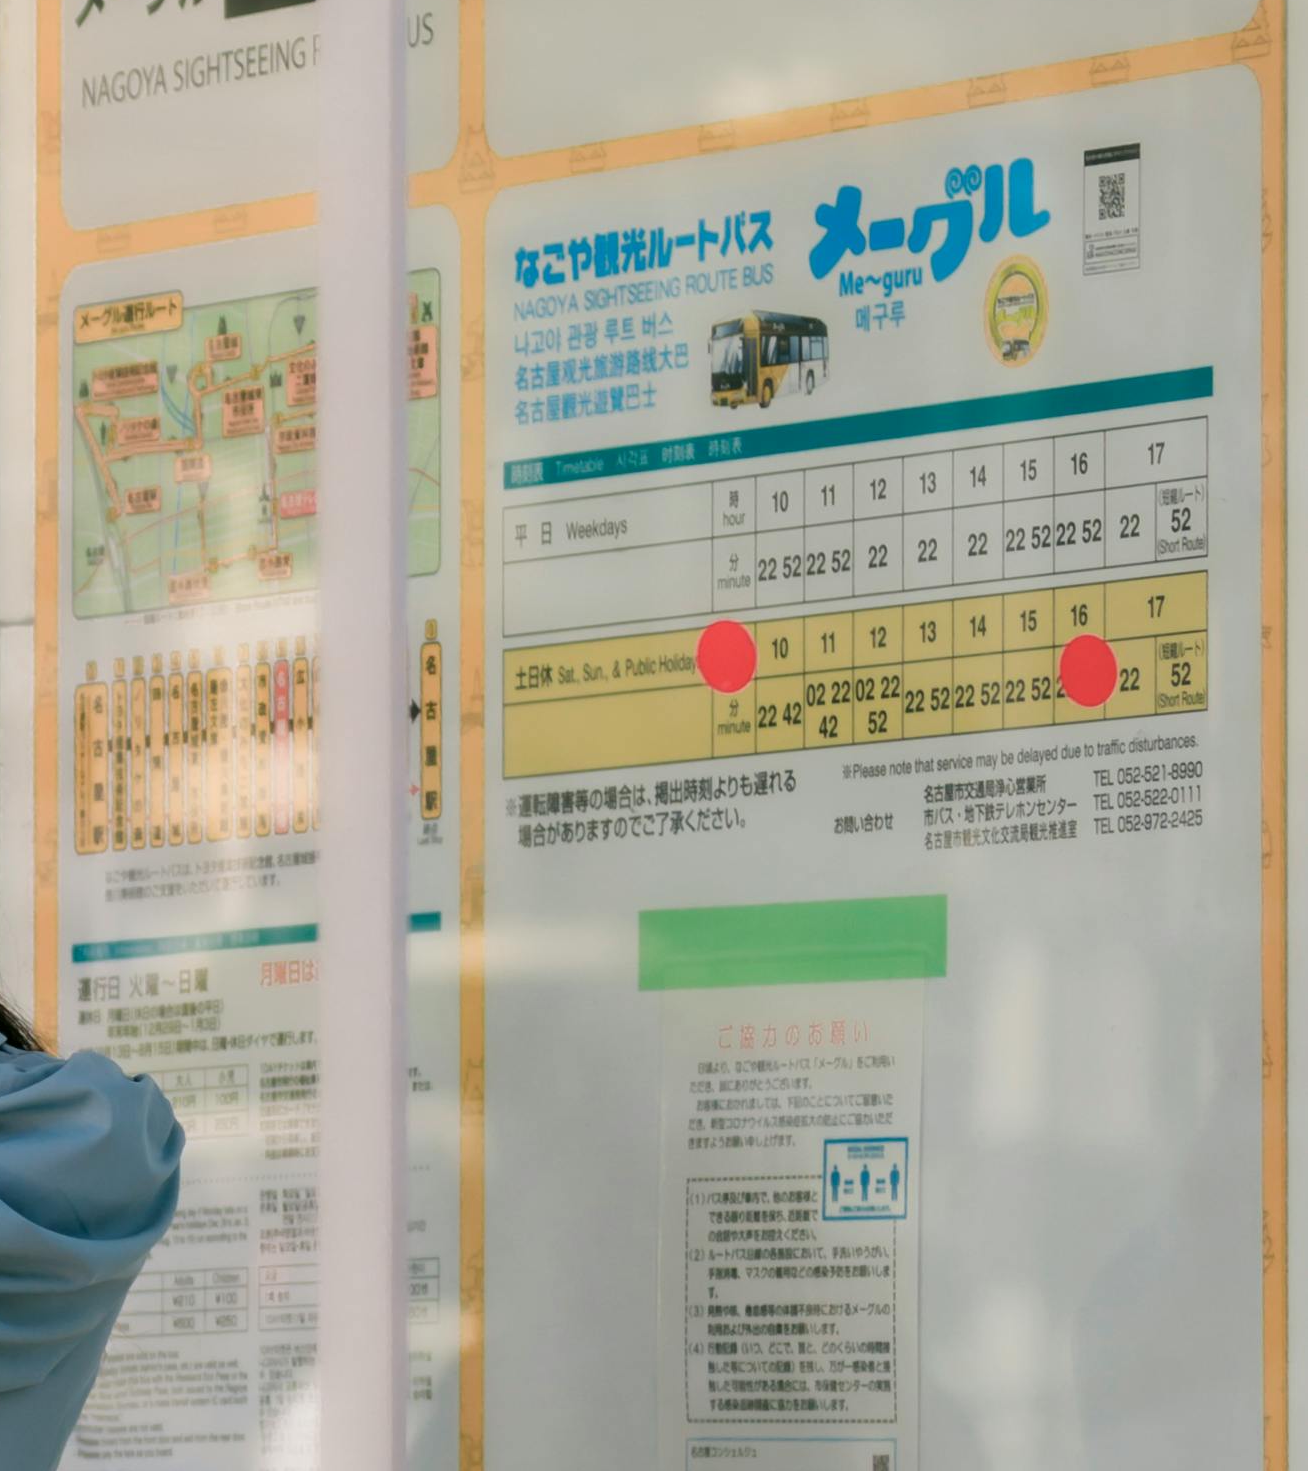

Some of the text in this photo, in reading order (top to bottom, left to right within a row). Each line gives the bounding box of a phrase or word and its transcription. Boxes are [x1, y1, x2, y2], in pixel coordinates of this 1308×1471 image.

[82, 12, 434, 108] NAGOYA SIGHTSEEING US
[809, 157, 1051, 282] メーグル
[515, 210, 774, 288] なごや観光ルートバス
[514, 263, 774, 321] NAGOYA SIGHTSEEING ROUTE BUS
[514, 327, 561, 356] 나고야
[604, 317, 635, 343] 루트
[641, 311, 673, 337] 버스
[771, 442, 1165, 512] 10 11 12 13 14 15 16 17
[566, 517, 628, 541] Weekdays
[723, 512, 745, 528] hour
[758, 507, 1191, 581] 22 52 22 52 22 22 22 22 52 22 52 22 52
[717, 574, 752, 590] minute
[771, 595, 1165, 659] 10 11 12 13 14 15 16 17
[514, 666, 553, 691] 土日休
[612, 662, 621, 680] &
[625, 657, 656, 678] Public
[758, 662, 1191, 739] 22 42 02 22 42 02 22 52 22 52 22 52 22 52 22 52
[717, 720, 751, 735] minute
[889, 732, 1199, 777] note that service may be delayed due to traffic disturbances.
[1093, 760, 1203, 787] TEL 052-521-8990
[1093, 785, 1201, 811] TEL 052-522-0111
[834, 813, 894, 834] お問い合わせ
[1094, 809, 1203, 834] TEL 052-972-2425
[717, 1019, 871, 1050] ご協力のお願い
